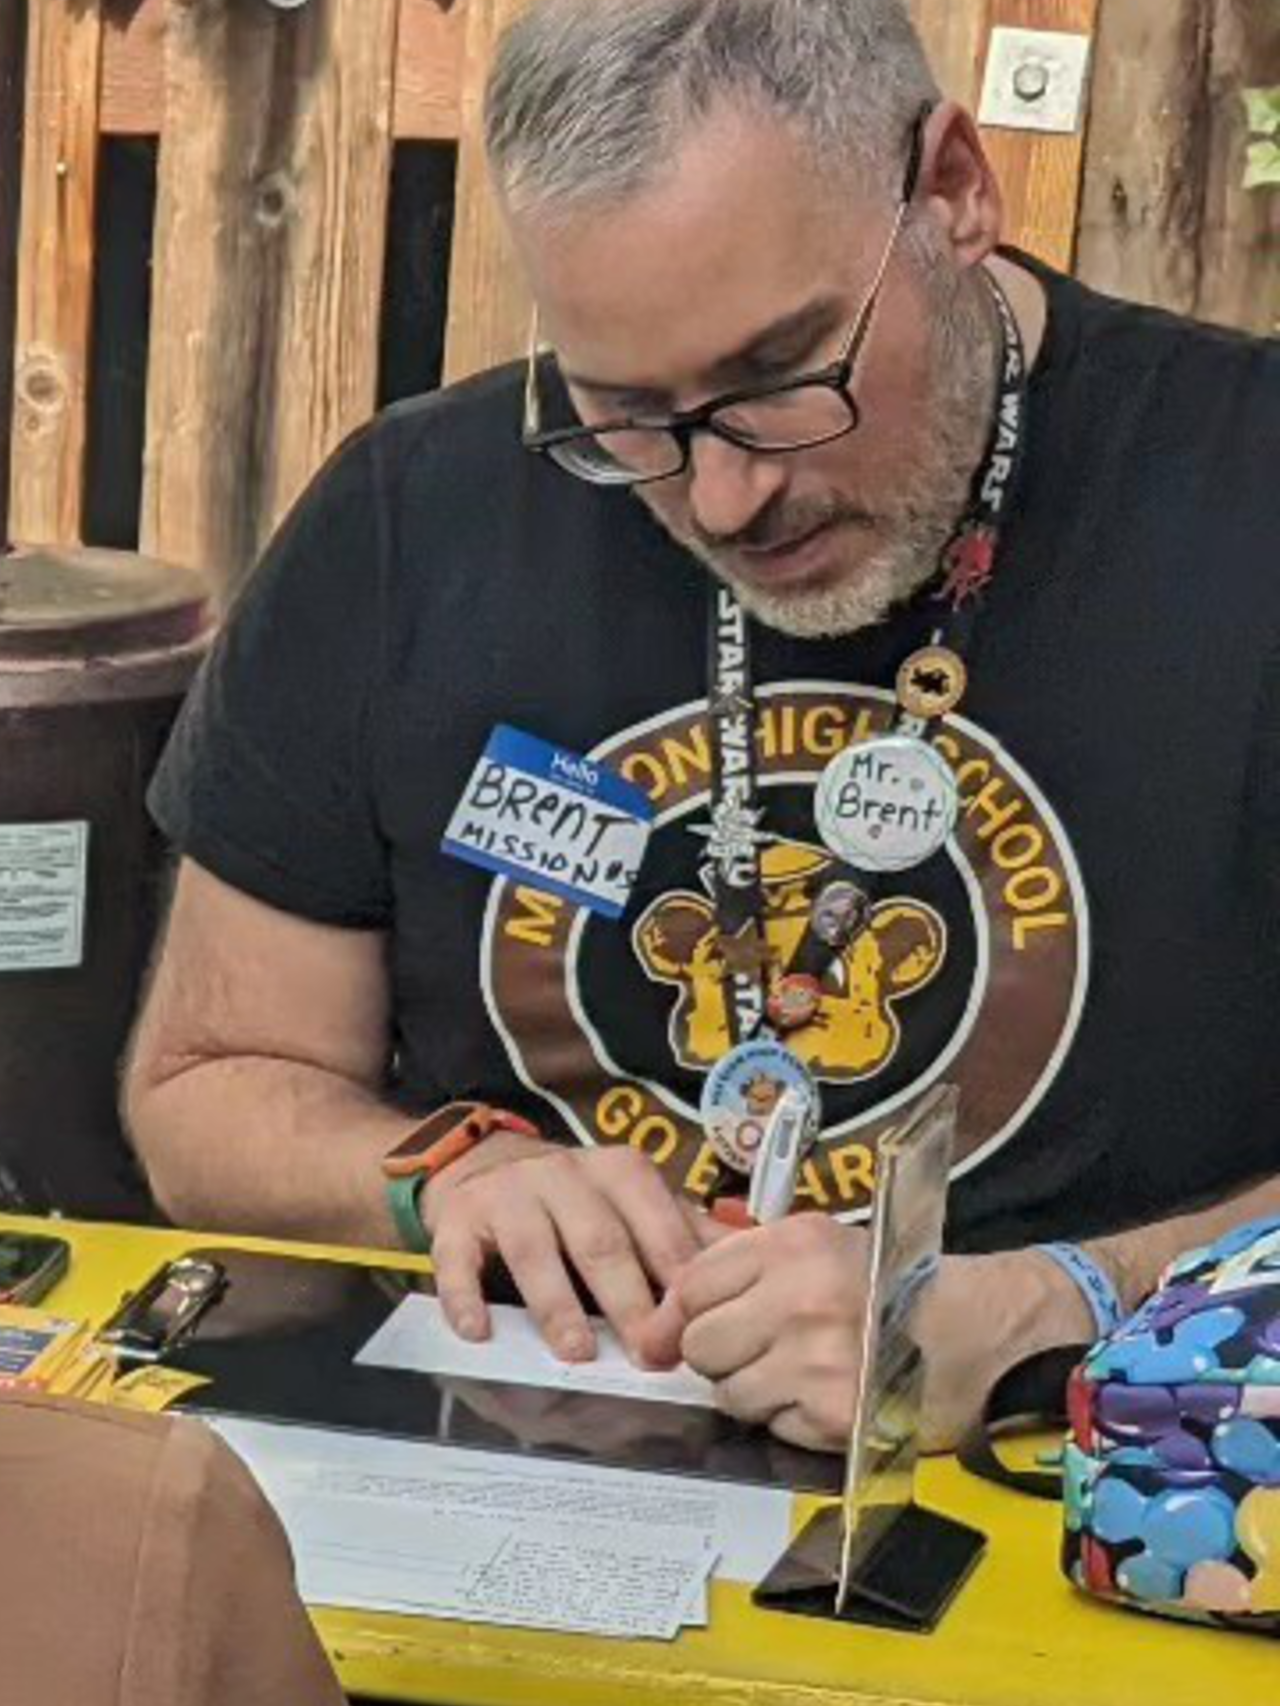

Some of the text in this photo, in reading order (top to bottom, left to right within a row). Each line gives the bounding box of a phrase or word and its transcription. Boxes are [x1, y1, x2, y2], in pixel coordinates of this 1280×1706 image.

[980, 393, 1022, 513] WARS
[849, 752, 901, 785] Mr.
[836, 781, 941, 832] Brent
[459, 822, 600, 884] MISSION
